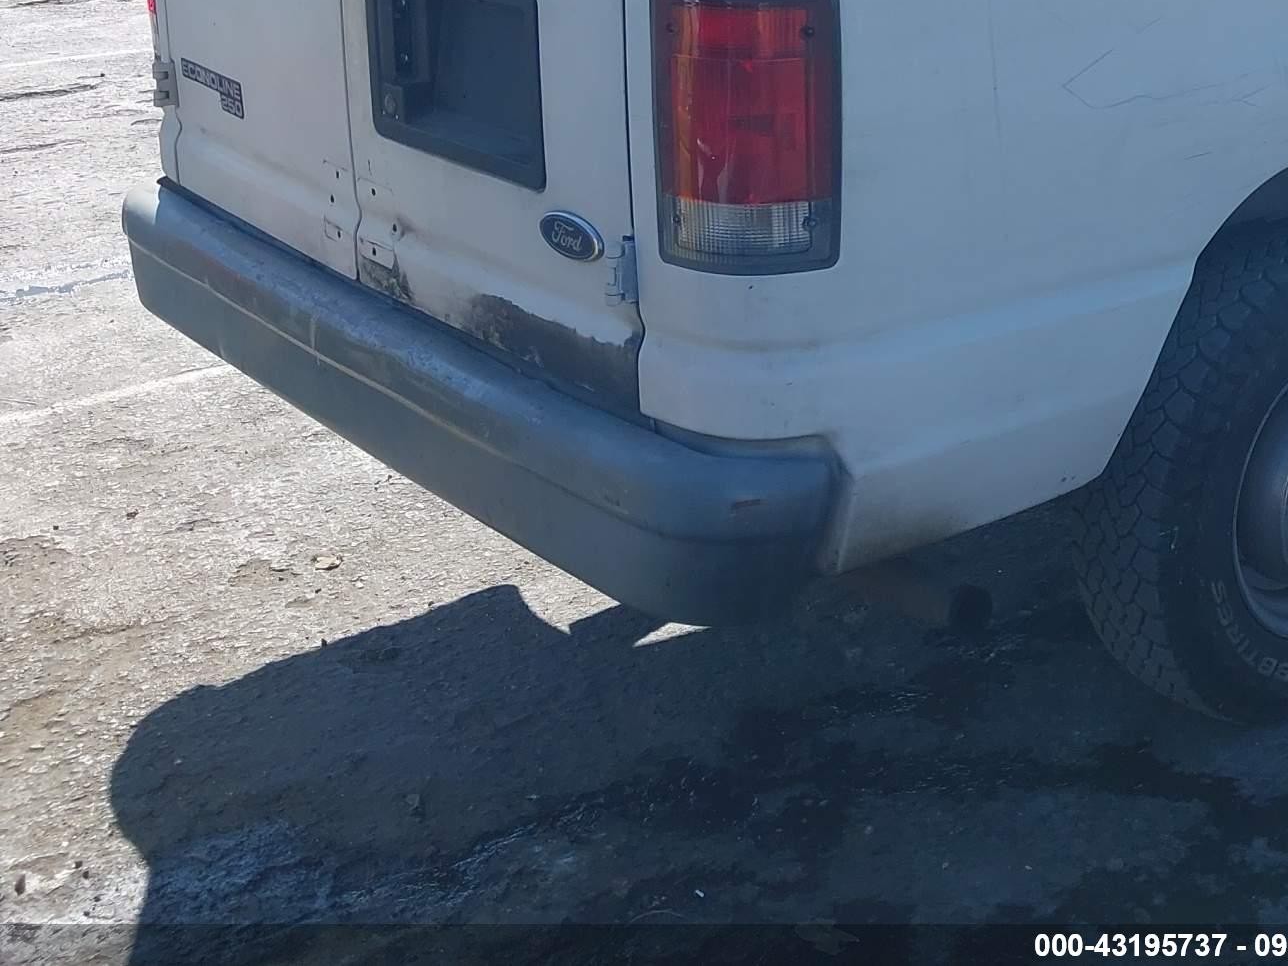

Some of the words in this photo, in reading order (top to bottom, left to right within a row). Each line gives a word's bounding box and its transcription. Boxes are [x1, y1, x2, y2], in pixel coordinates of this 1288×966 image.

[182, 60, 241, 100] ECONOLINE
[221, 95, 243, 117] 250
[551, 221, 583, 251] Ford
